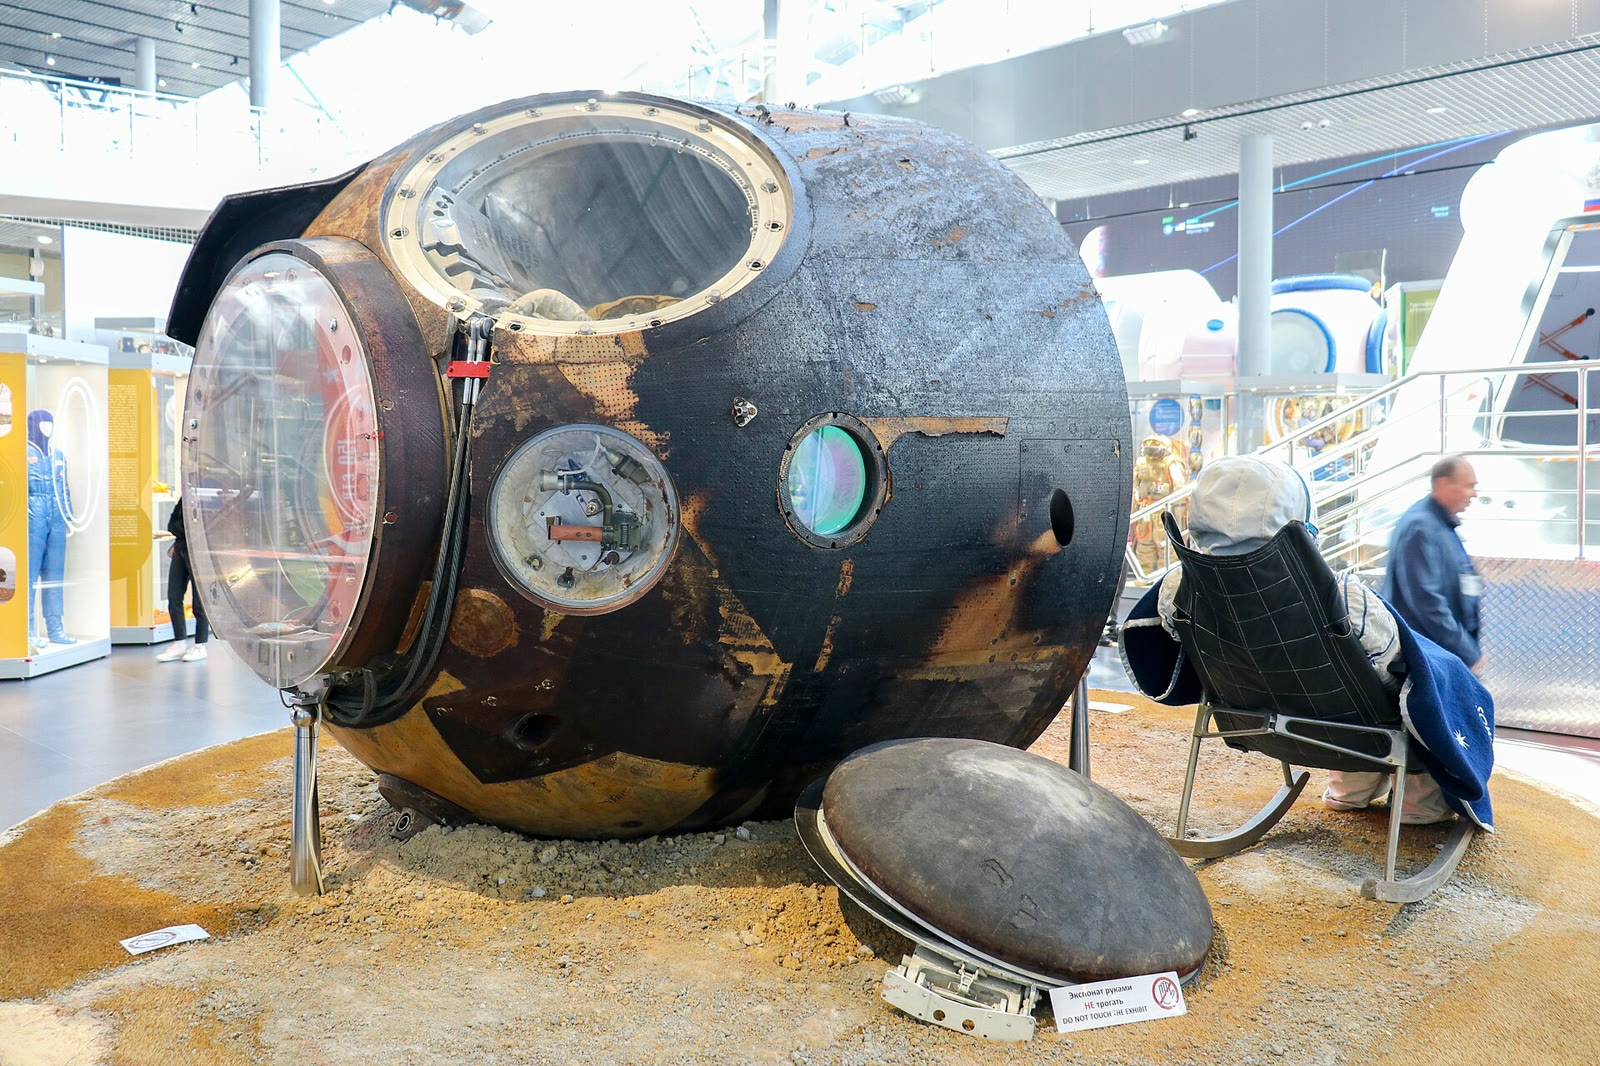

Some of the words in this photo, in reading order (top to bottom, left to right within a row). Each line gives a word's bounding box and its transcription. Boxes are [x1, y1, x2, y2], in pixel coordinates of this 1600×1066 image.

[1068, 989, 1104, 999] Экспонат
[1105, 985, 1132, 996] руками
[1084, 1001, 1095, 1010] НЕ
[1096, 999, 1124, 1009] трогать
[1062, 1017, 1074, 1025] DO
[1074, 1014, 1089, 1023] NOT
[1090, 1011, 1112, 1020] TOUCH
[1125, 1005, 1148, 1015] EXHIBIT
